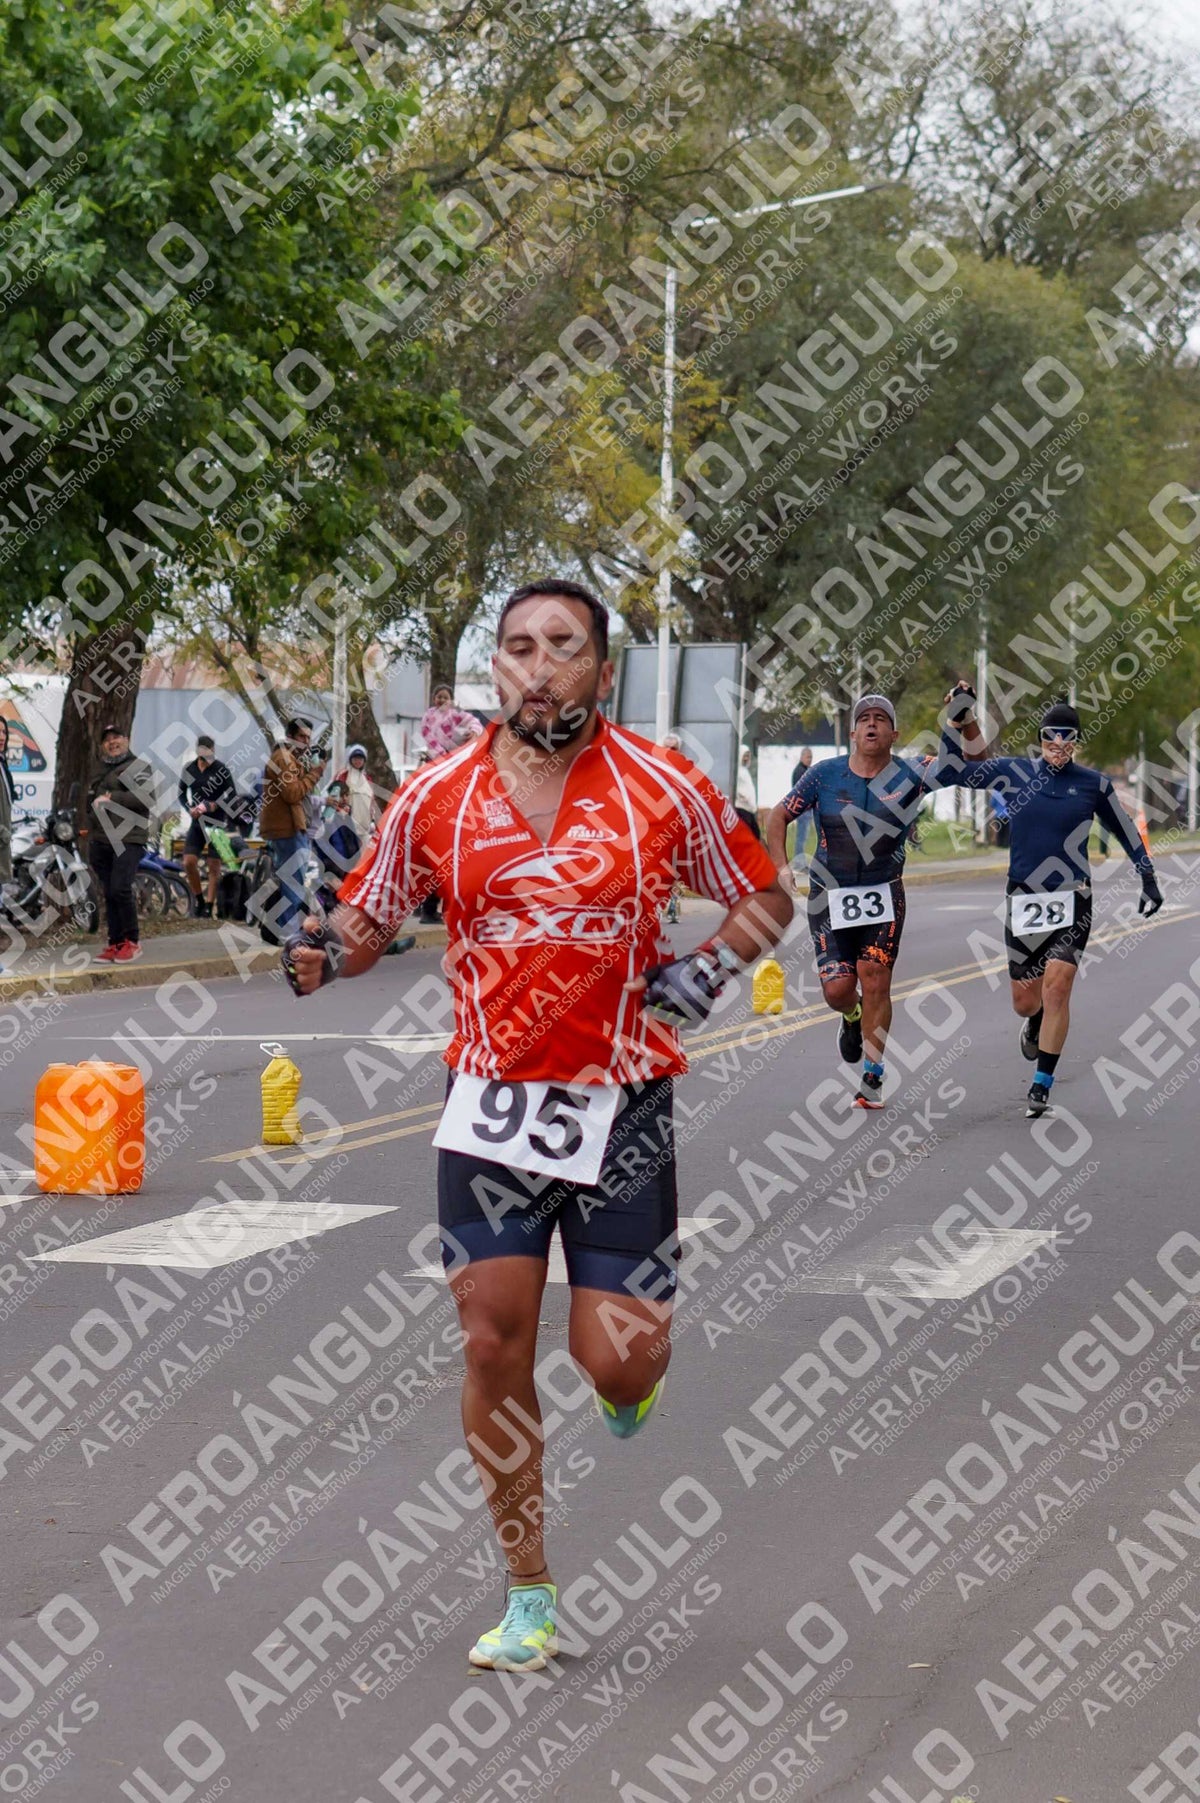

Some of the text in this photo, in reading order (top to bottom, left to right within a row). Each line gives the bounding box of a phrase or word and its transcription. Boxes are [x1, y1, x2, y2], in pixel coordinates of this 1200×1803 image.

[841, 891, 885, 921] 83
[1022, 901, 1066, 929] 28
[472, 1081, 591, 1160] 95
